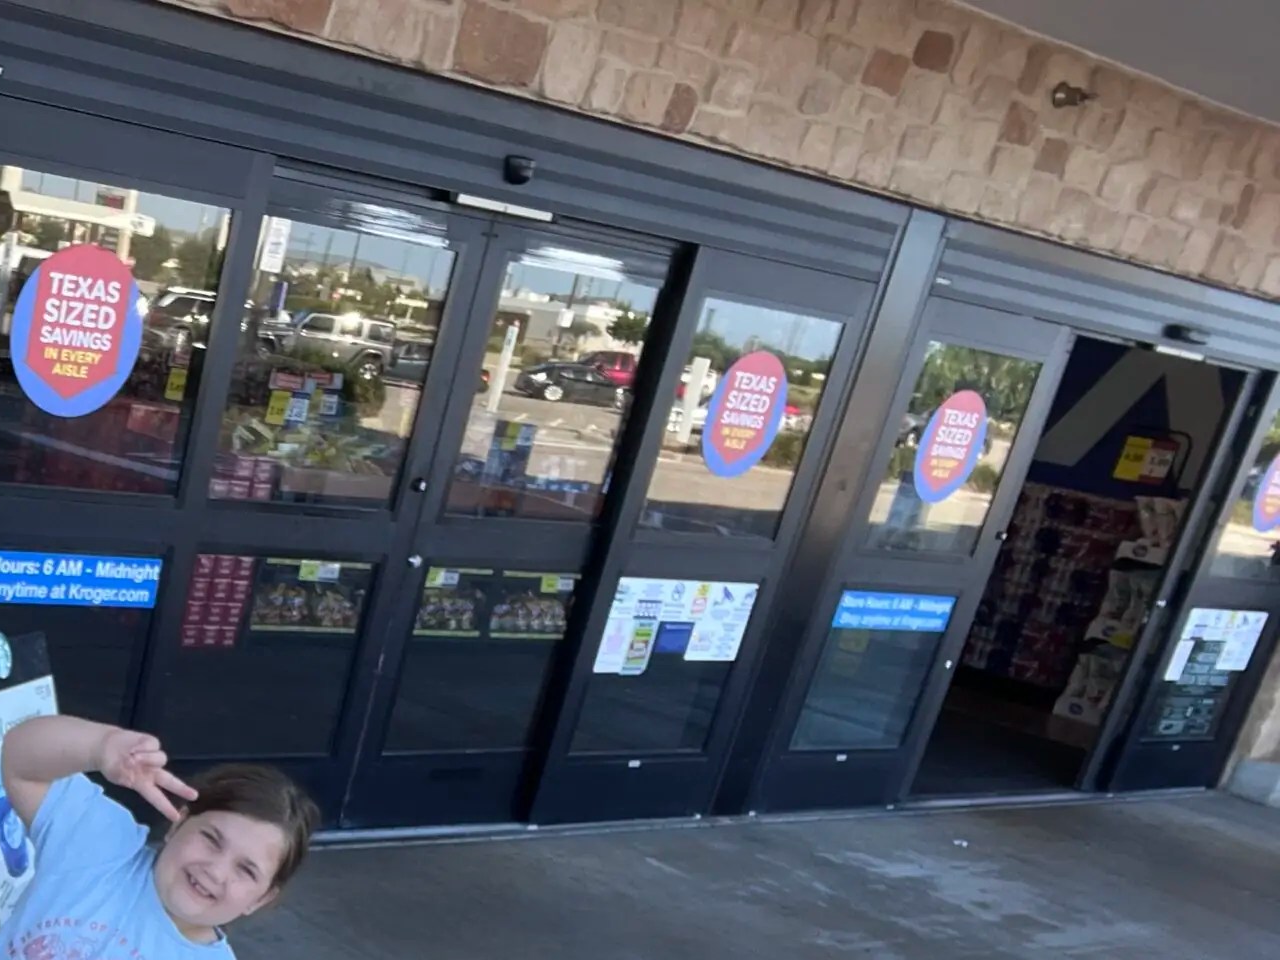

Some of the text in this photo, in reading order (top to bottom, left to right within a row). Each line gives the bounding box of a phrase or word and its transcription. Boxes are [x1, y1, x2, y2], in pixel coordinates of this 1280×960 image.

[49, 272, 122, 303] TEXAS
[43, 298, 116, 329] SIZED
[40, 325, 112, 351] SAVINGS
[43, 347, 102, 365] IN EVERY
[52, 363, 88, 378] AISLE
[735, 371, 778, 393] TEXAS
[726, 390, 770, 413] SIZED
[721, 410, 764, 429] SAVINGS
[944, 408, 979, 428] TEXAS
[935, 426, 972, 446] SIZED
[42, 559, 54, 575] 6
[56, 560, 82, 576] AM
[95, 561, 160, 583] Midnight
[50, 584, 65, 600] at
[69, 583, 149, 604] Kroger.com
